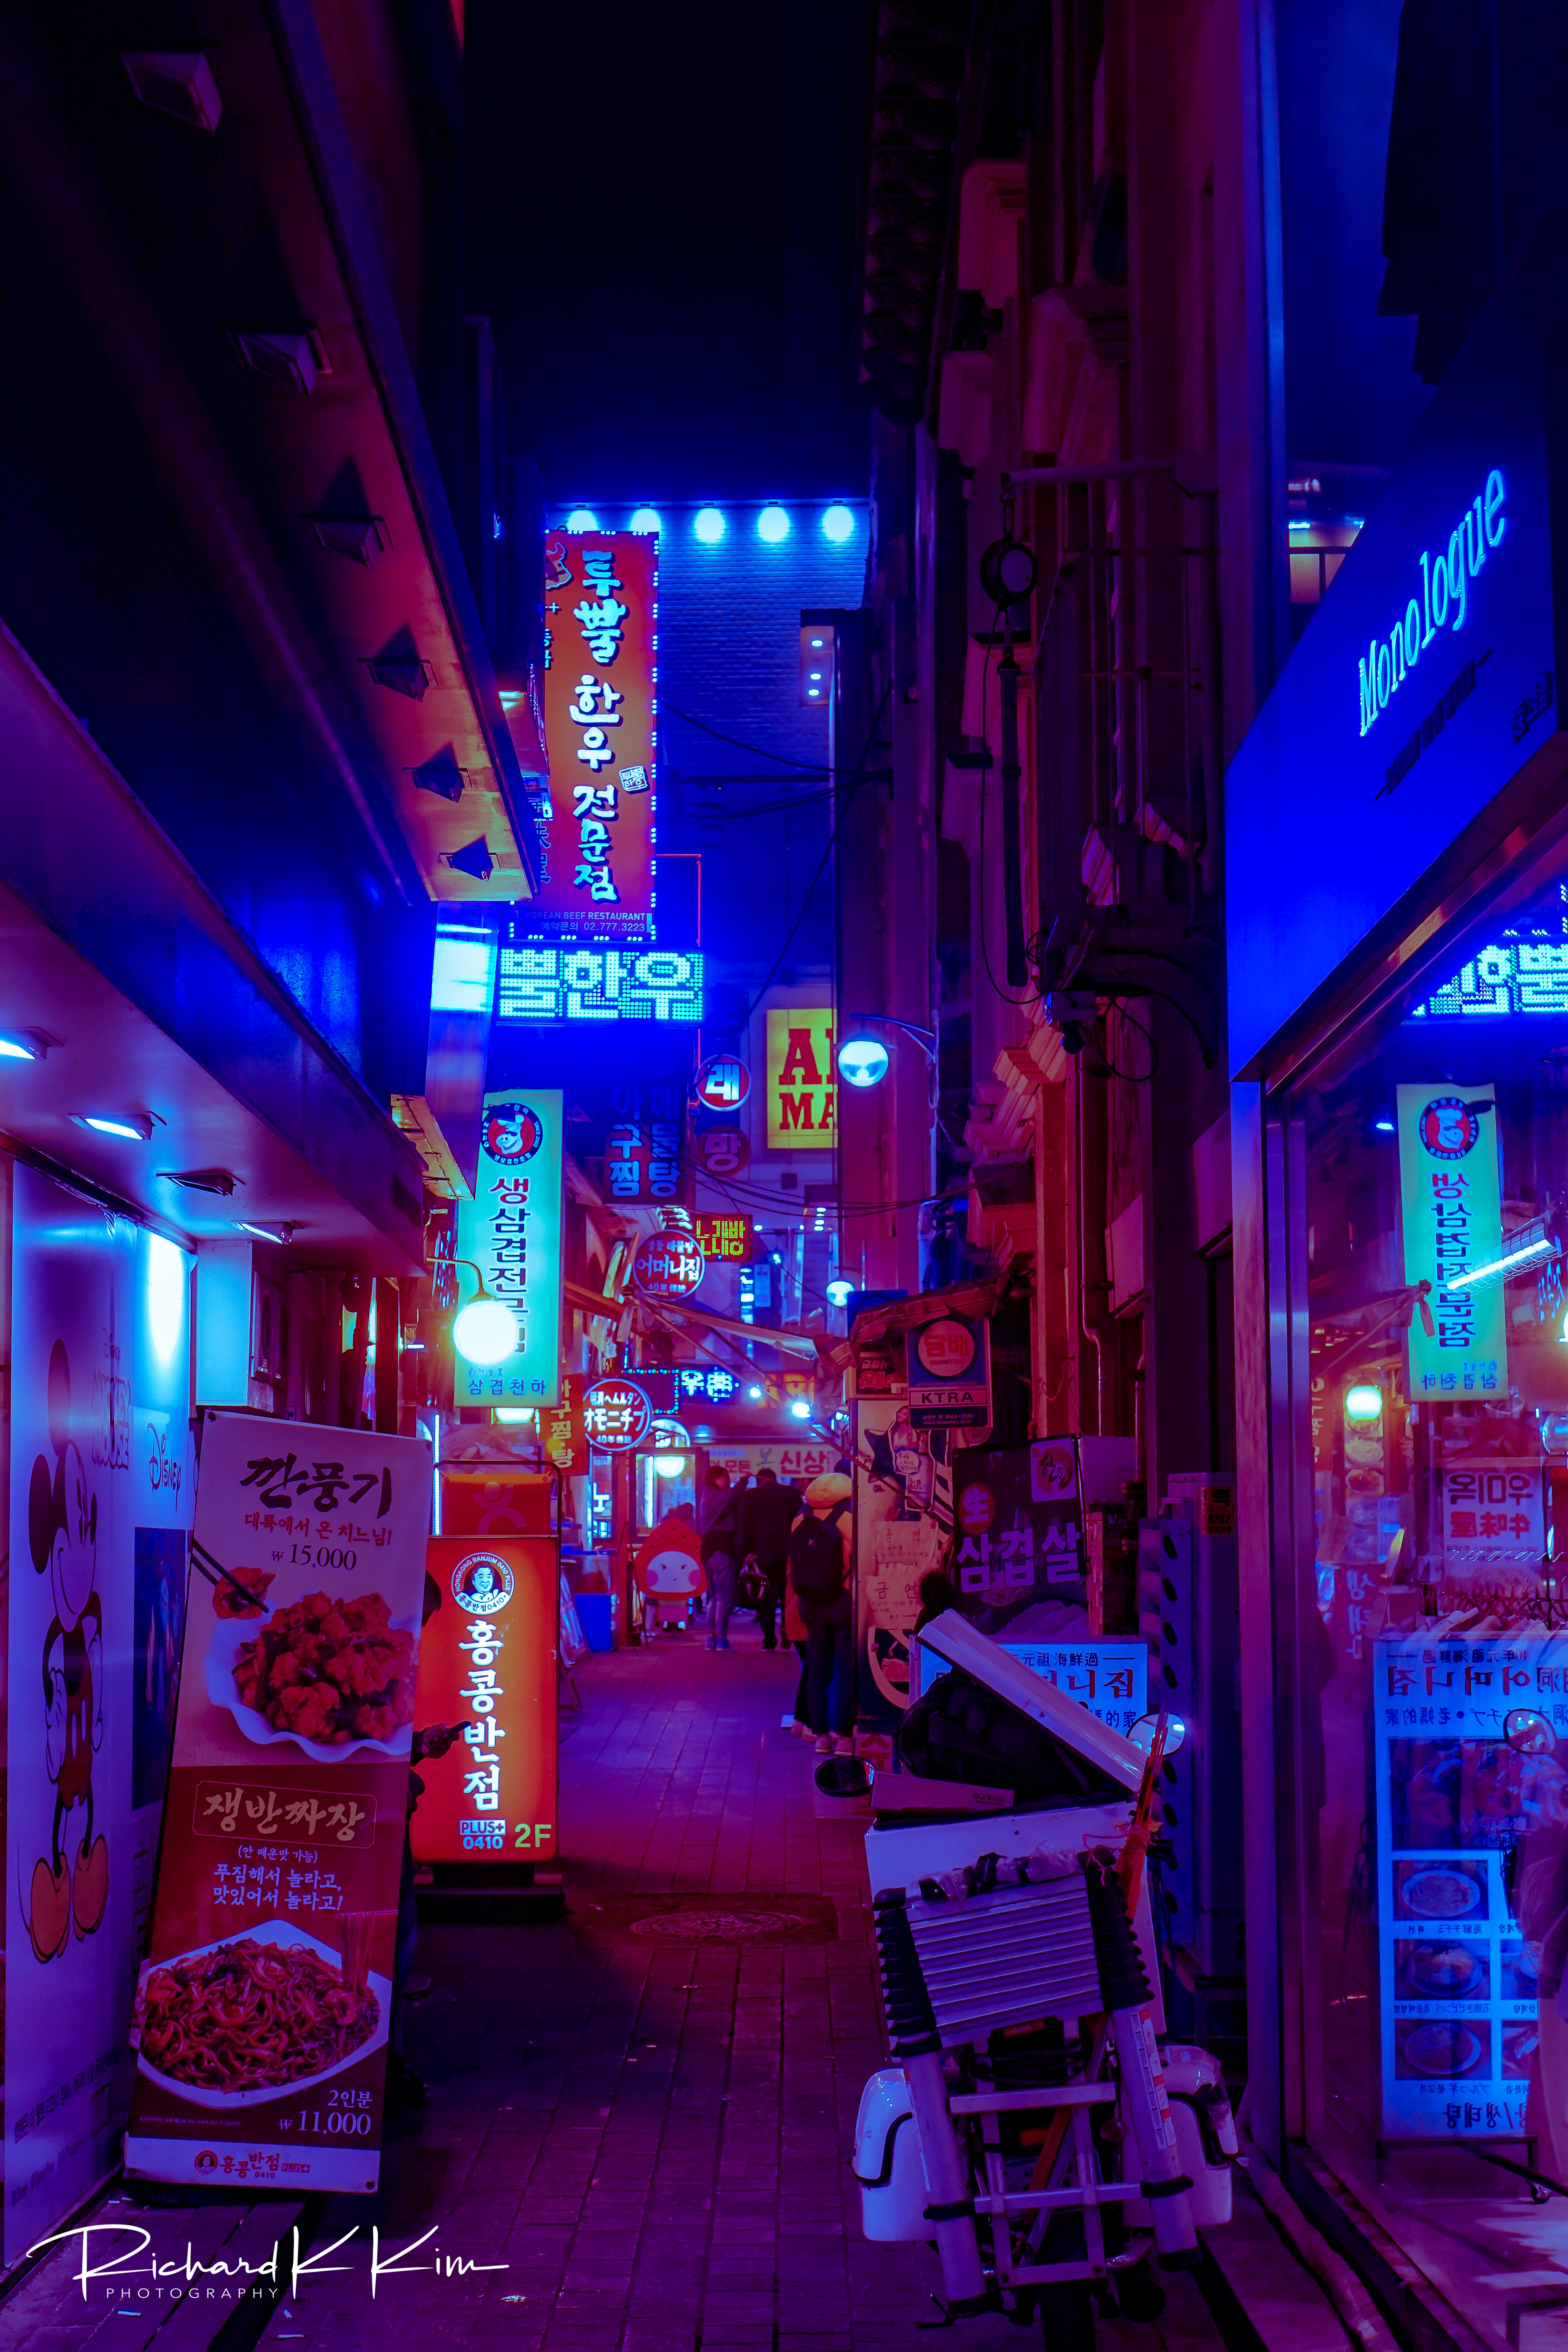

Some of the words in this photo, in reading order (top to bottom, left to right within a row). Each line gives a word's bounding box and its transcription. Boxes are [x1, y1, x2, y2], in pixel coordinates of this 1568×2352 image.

[573, 550, 626, 663] 투뿔
[1359, 469, 1506, 736] Monologue
[569, 675, 621, 769] 한우
[572, 784, 617, 900] 전문점
[542, 922, 578, 931] 예약문의
[584, 922, 645, 931] 02.777.3223
[588, 912, 645, 921] RESTAURANT
[635, 1253, 701, 1281] 어머니집
[924, 1334, 969, 1357] 담배
[468, 1379, 546, 1396] 삼겹천하
[922, 1392, 973, 1404] KTRA
[239, 1452, 392, 1519] 깐풍기
[963, 1488, 989, 1524] 生
[245, 1512, 310, 1538] 대륙에서
[315, 1521, 332, 1539] 온
[337, 1523, 392, 1546] 치느님!
[290, 1544, 357, 1570] 15,000
[956, 1522, 1080, 1593] 삼겹살
[454, 1560, 472, 1592] HONGKONG
[472, 1555, 498, 1564] BANJUM
[497, 1561, 509, 1575] 0410
[458, 1619, 506, 1811] 홍콩반점
[203, 1788, 365, 1842] 쟁반짜장
[463, 1835, 504, 1851] 0410
[514, 1823, 552, 1849] 2F
[238, 1844, 254, 1858] (안
[257, 1846, 289, 1861] 매운맛
[292, 1849, 318, 1864] 가능)
[214, 1863, 280, 1886] 푸짐해서
[286, 1869, 341, 1892] 놀라고,
[214, 1884, 278, 1909] 맛있어서
[284, 1891, 343, 1911] 놀라고!
[328, 2090, 373, 2109] 2인분
[298, 2110, 372, 2136] 11,000
[219, 2151, 281, 2179] 홍콩반점
